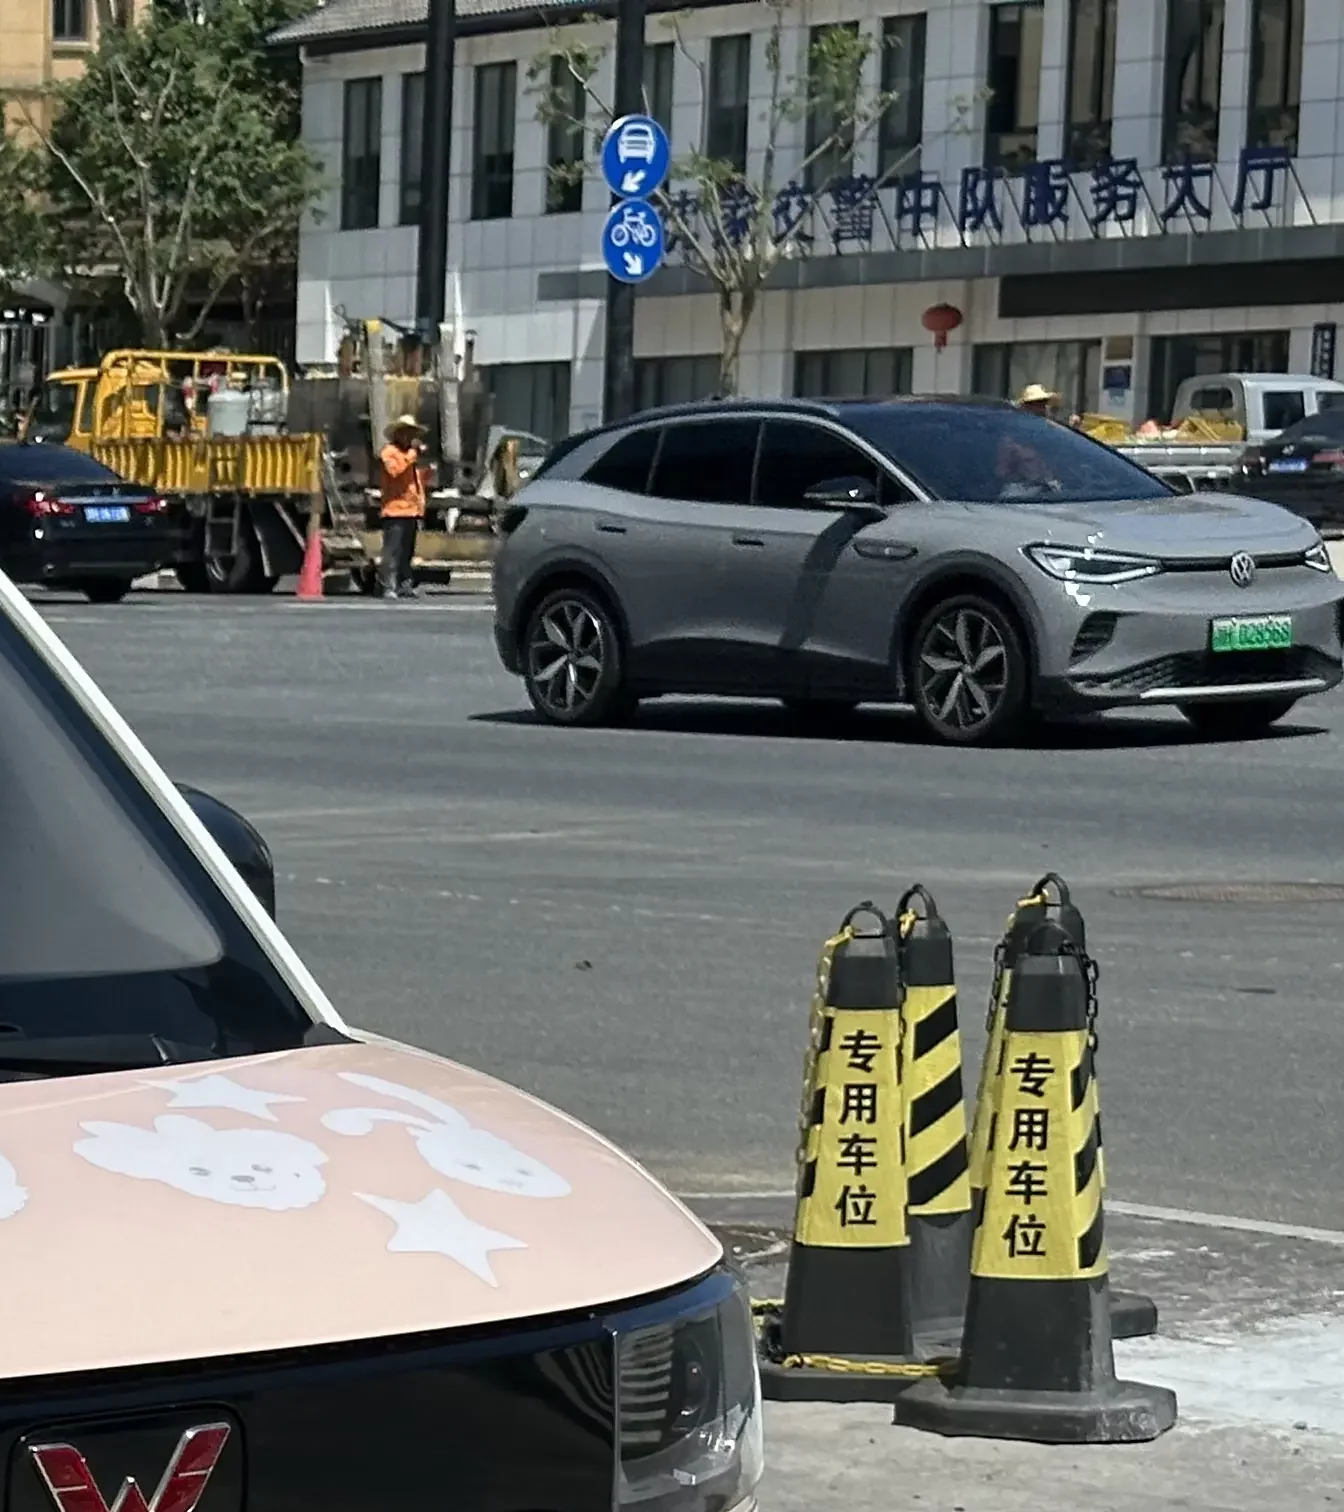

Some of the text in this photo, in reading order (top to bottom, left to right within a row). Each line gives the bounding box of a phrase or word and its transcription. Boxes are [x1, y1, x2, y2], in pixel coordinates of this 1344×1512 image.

[835, 1029, 882, 1228] 专用车位
[1002, 1052, 1054, 1258] 专用车位
